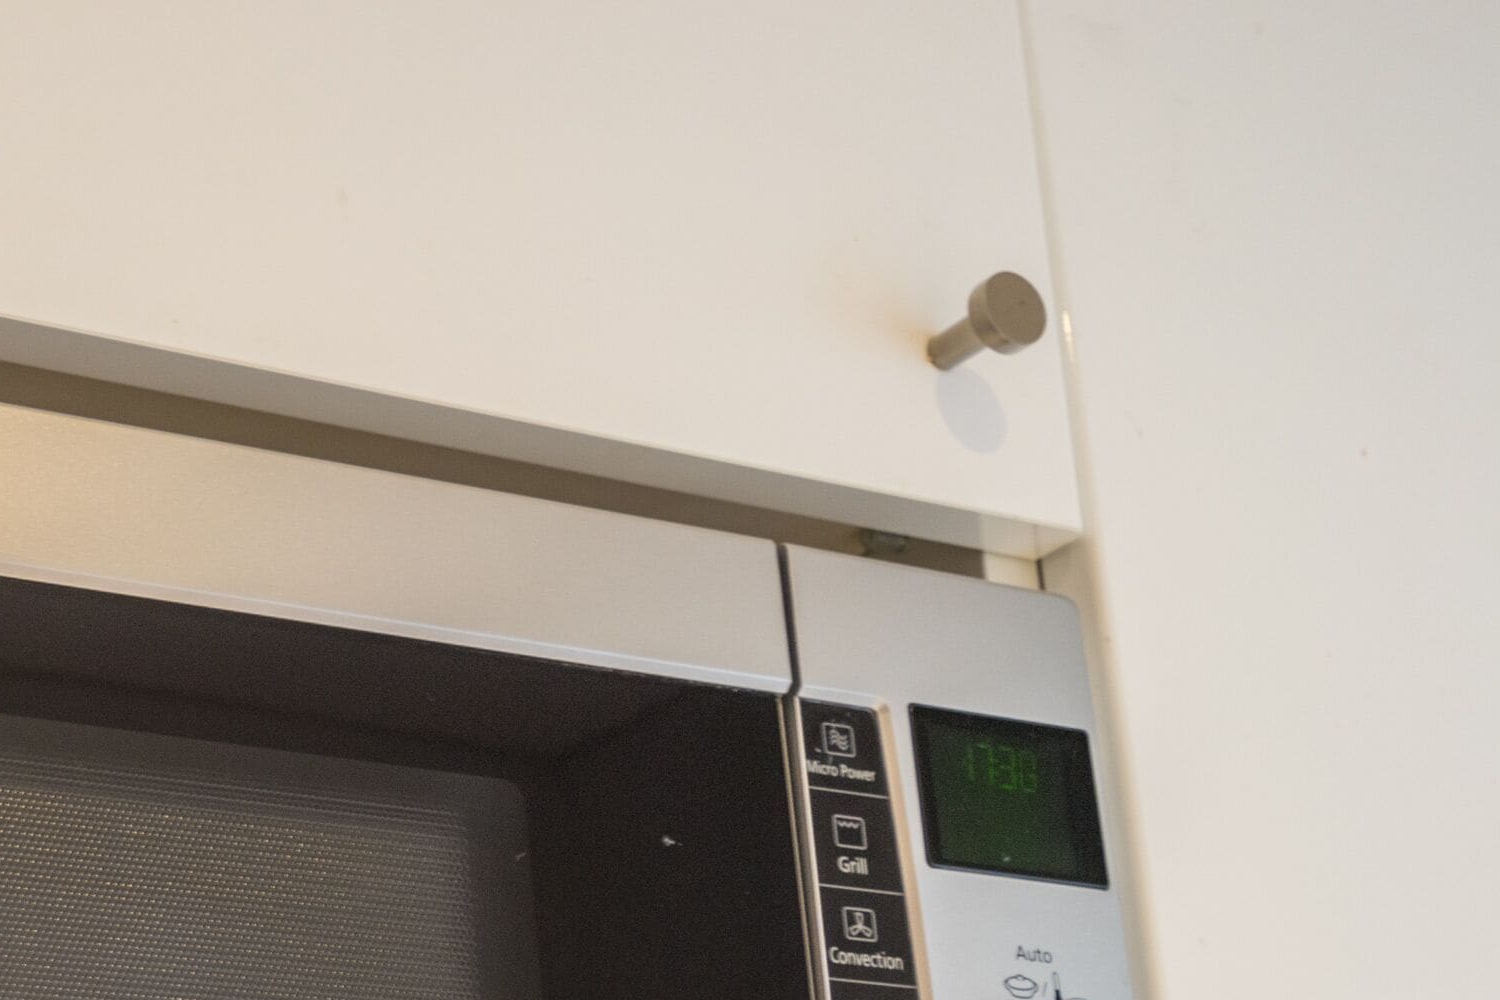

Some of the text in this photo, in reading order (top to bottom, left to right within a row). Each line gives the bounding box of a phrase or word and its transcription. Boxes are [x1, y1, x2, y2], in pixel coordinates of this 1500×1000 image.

[807, 760, 876, 782] Micro Power
[837, 855, 868, 875] Grill
[829, 946, 904, 971] Convection
[1016, 945, 1053, 964] Auto
